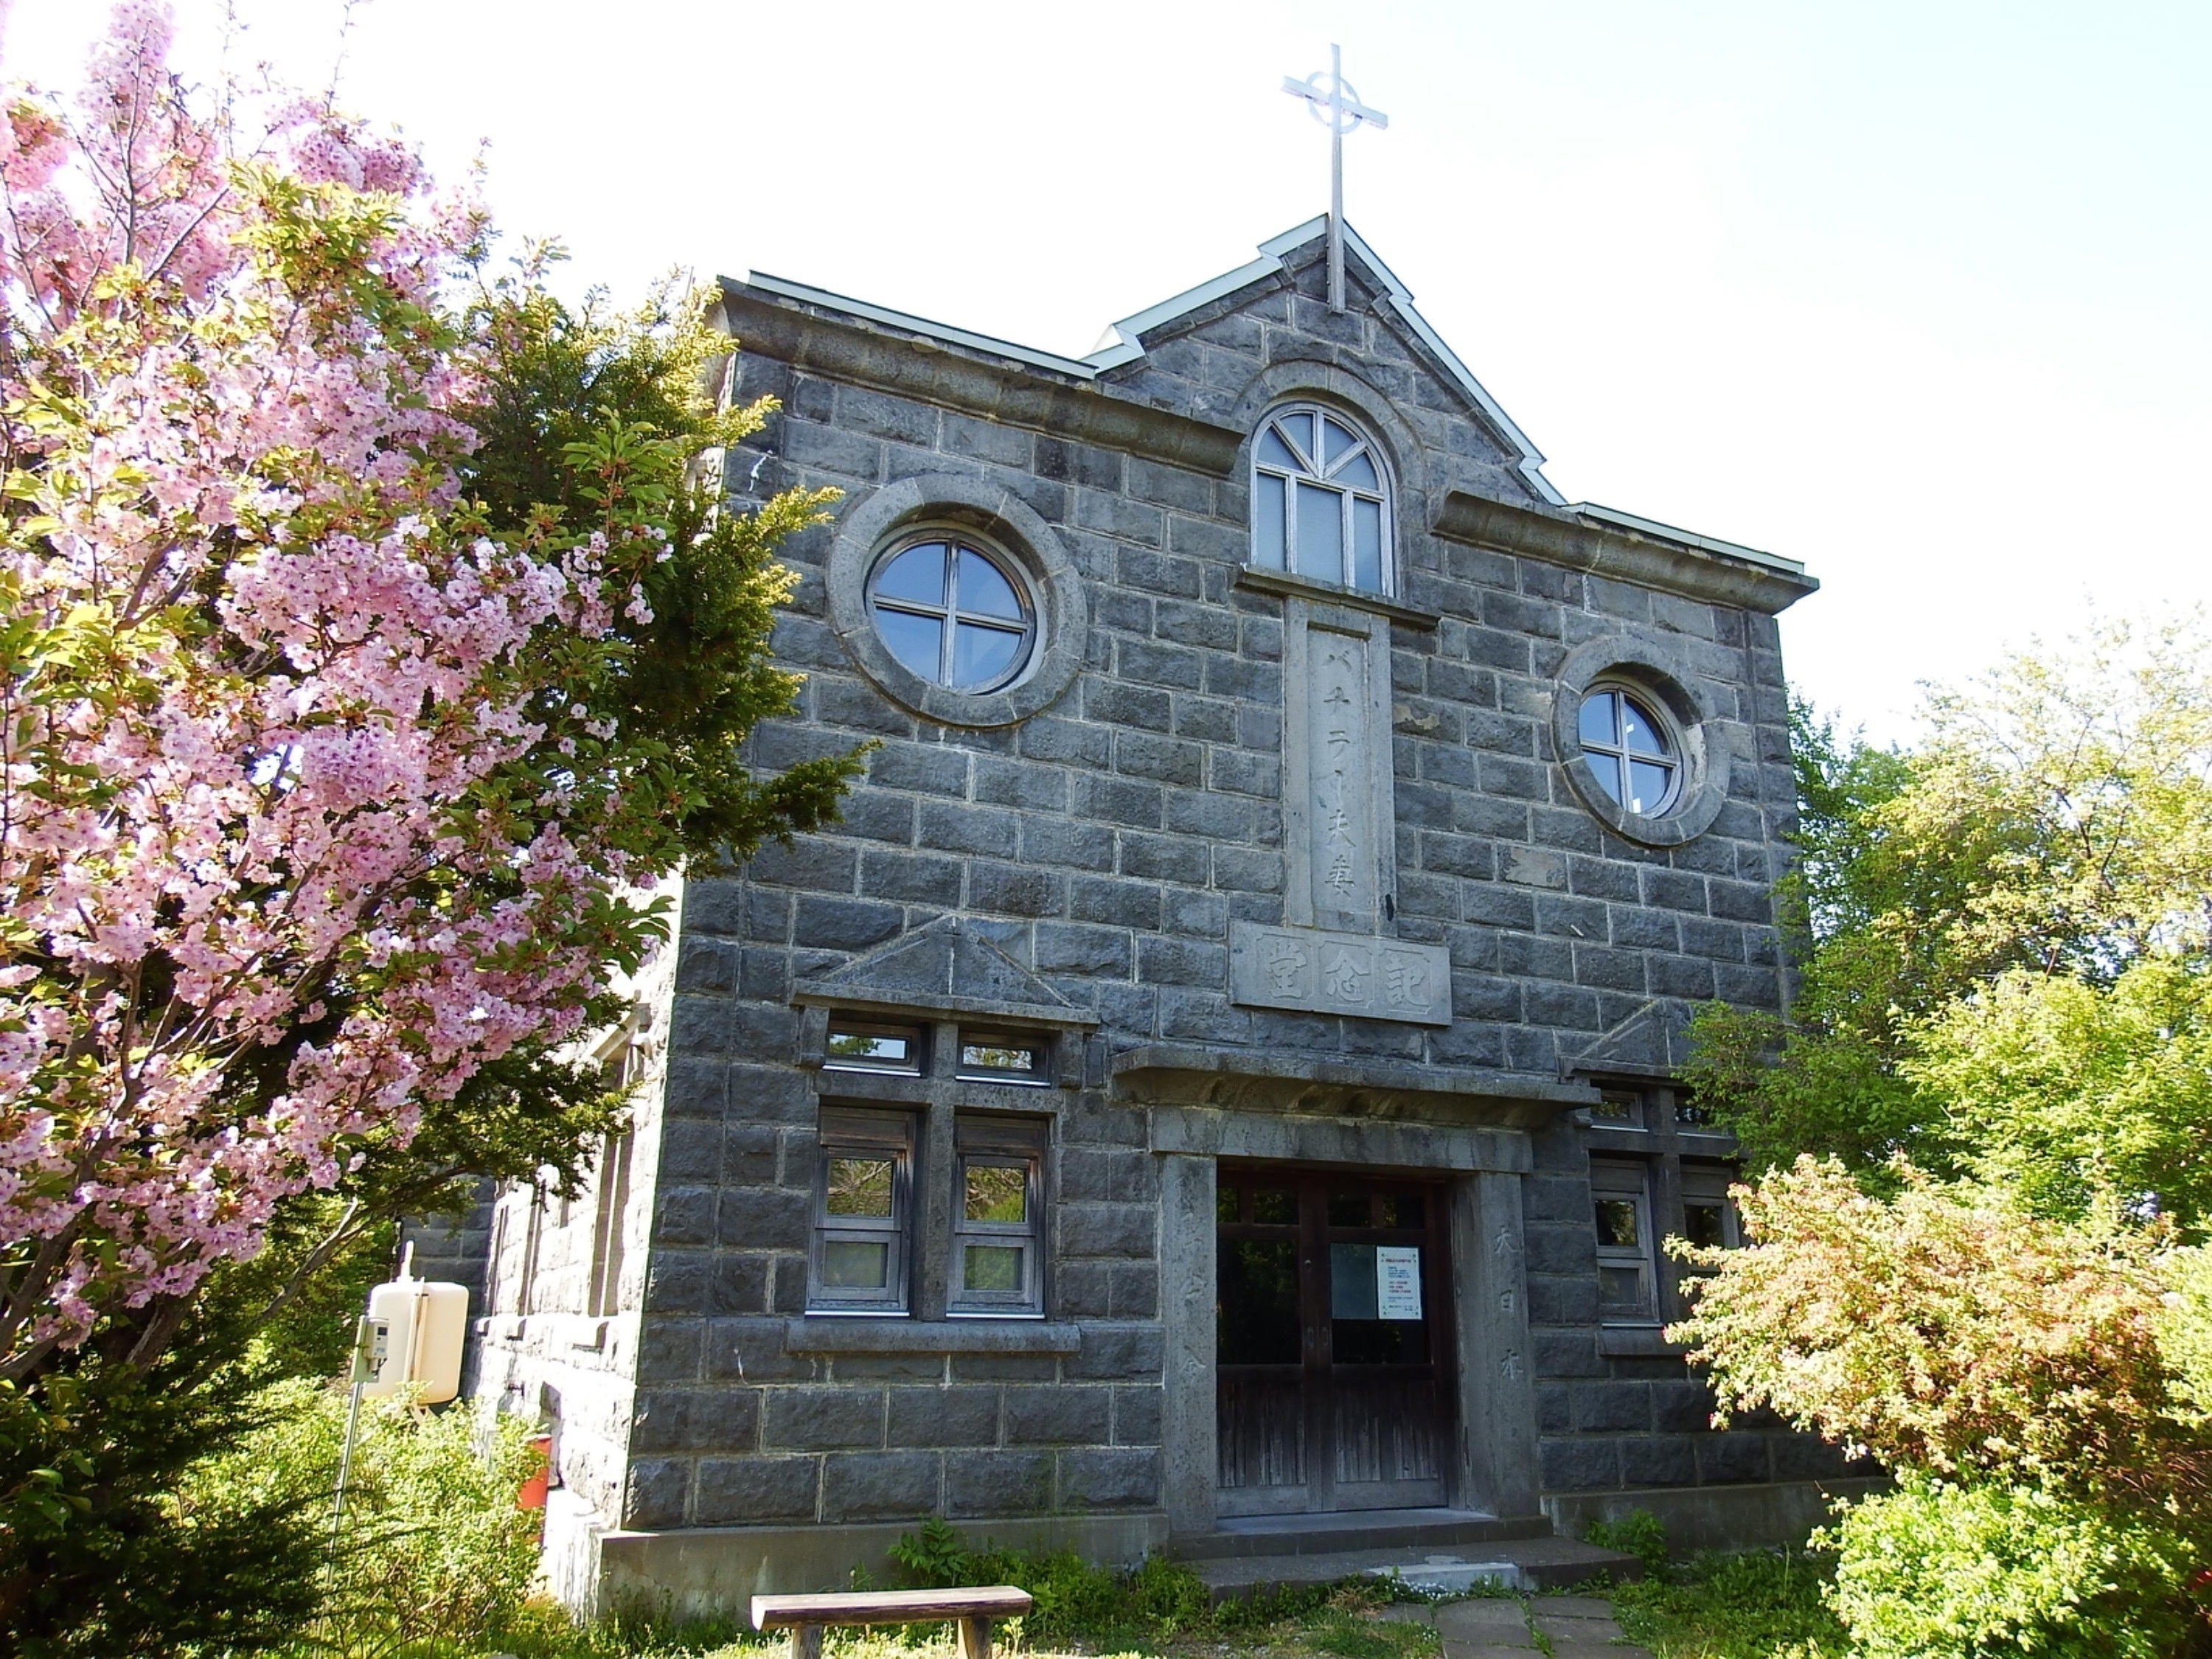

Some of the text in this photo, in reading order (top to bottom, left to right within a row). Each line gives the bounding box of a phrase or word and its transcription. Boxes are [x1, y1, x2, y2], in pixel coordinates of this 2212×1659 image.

[1321, 650, 1357, 898] バチラー夫妻
[1494, 1224, 1524, 1380] 大日本
